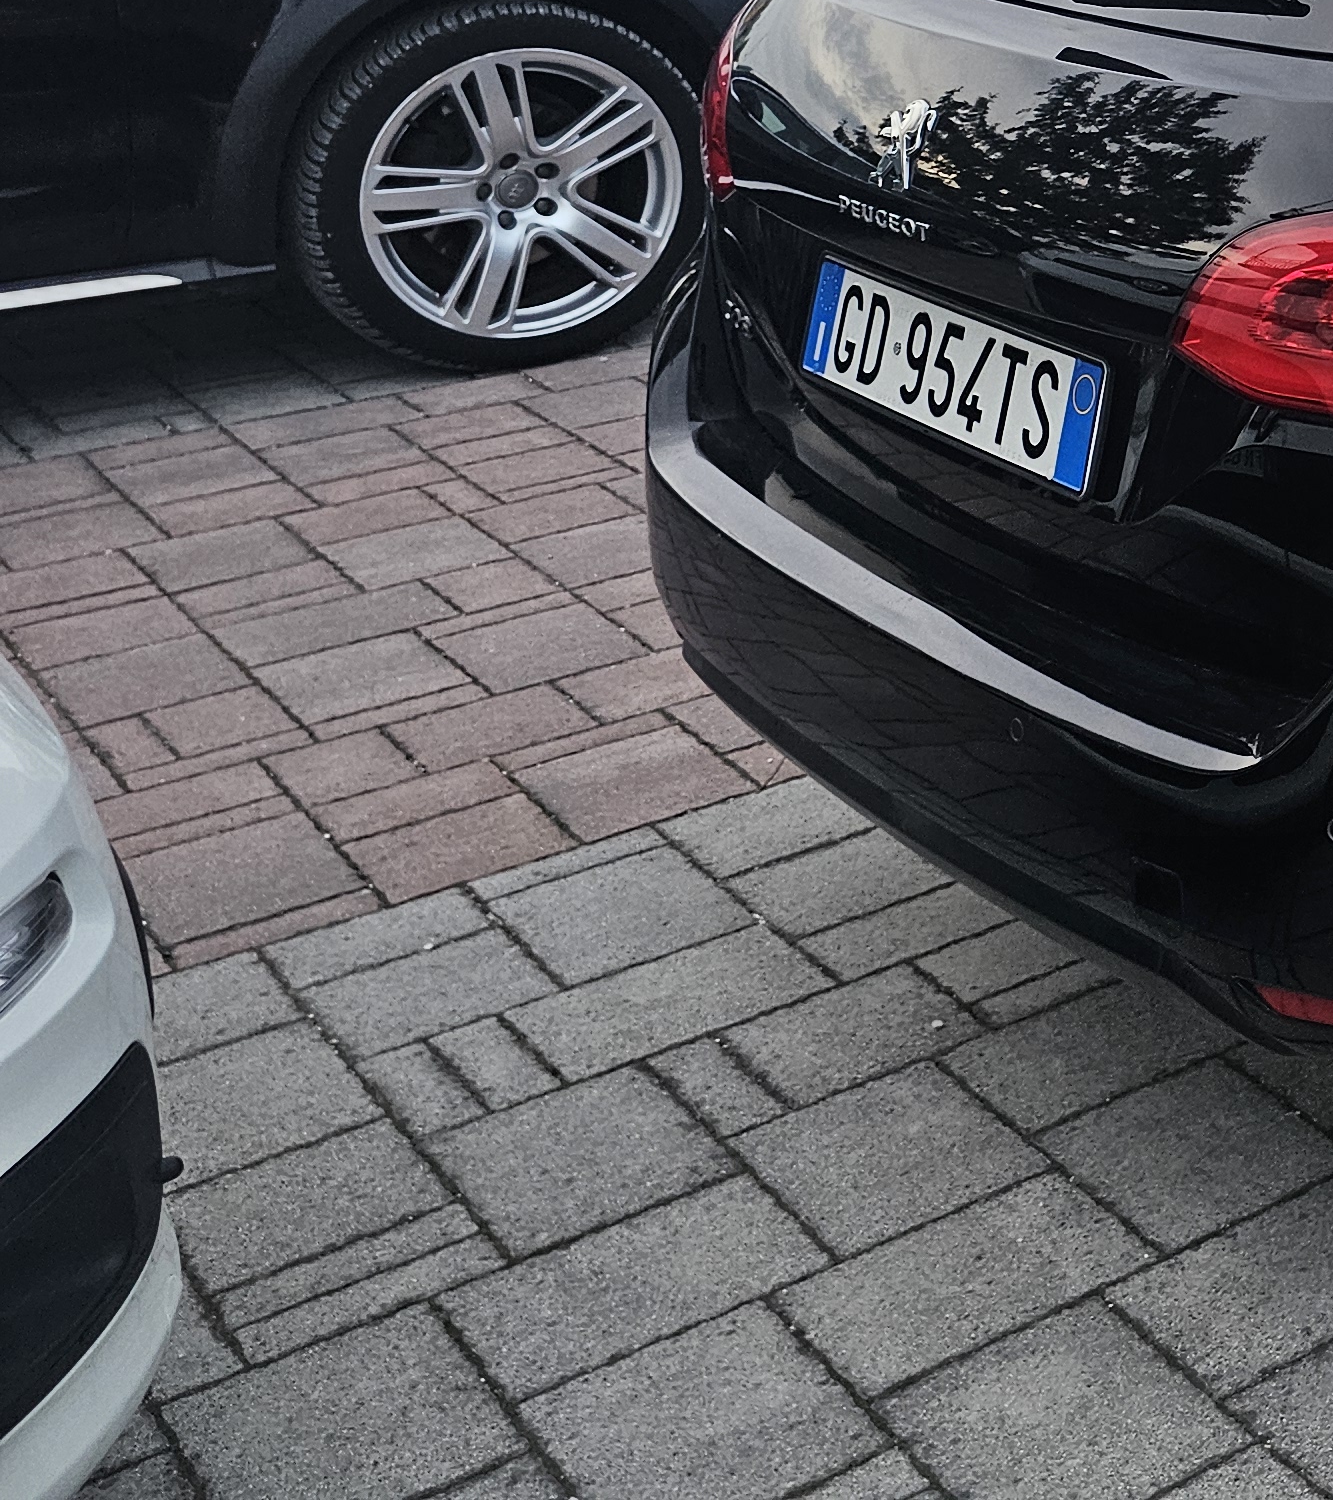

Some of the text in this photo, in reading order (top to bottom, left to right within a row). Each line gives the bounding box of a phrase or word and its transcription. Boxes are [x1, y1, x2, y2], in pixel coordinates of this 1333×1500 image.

[838, 194, 931, 242] PEUGEOT
[833, 284, 1060, 460] GD 954TS
